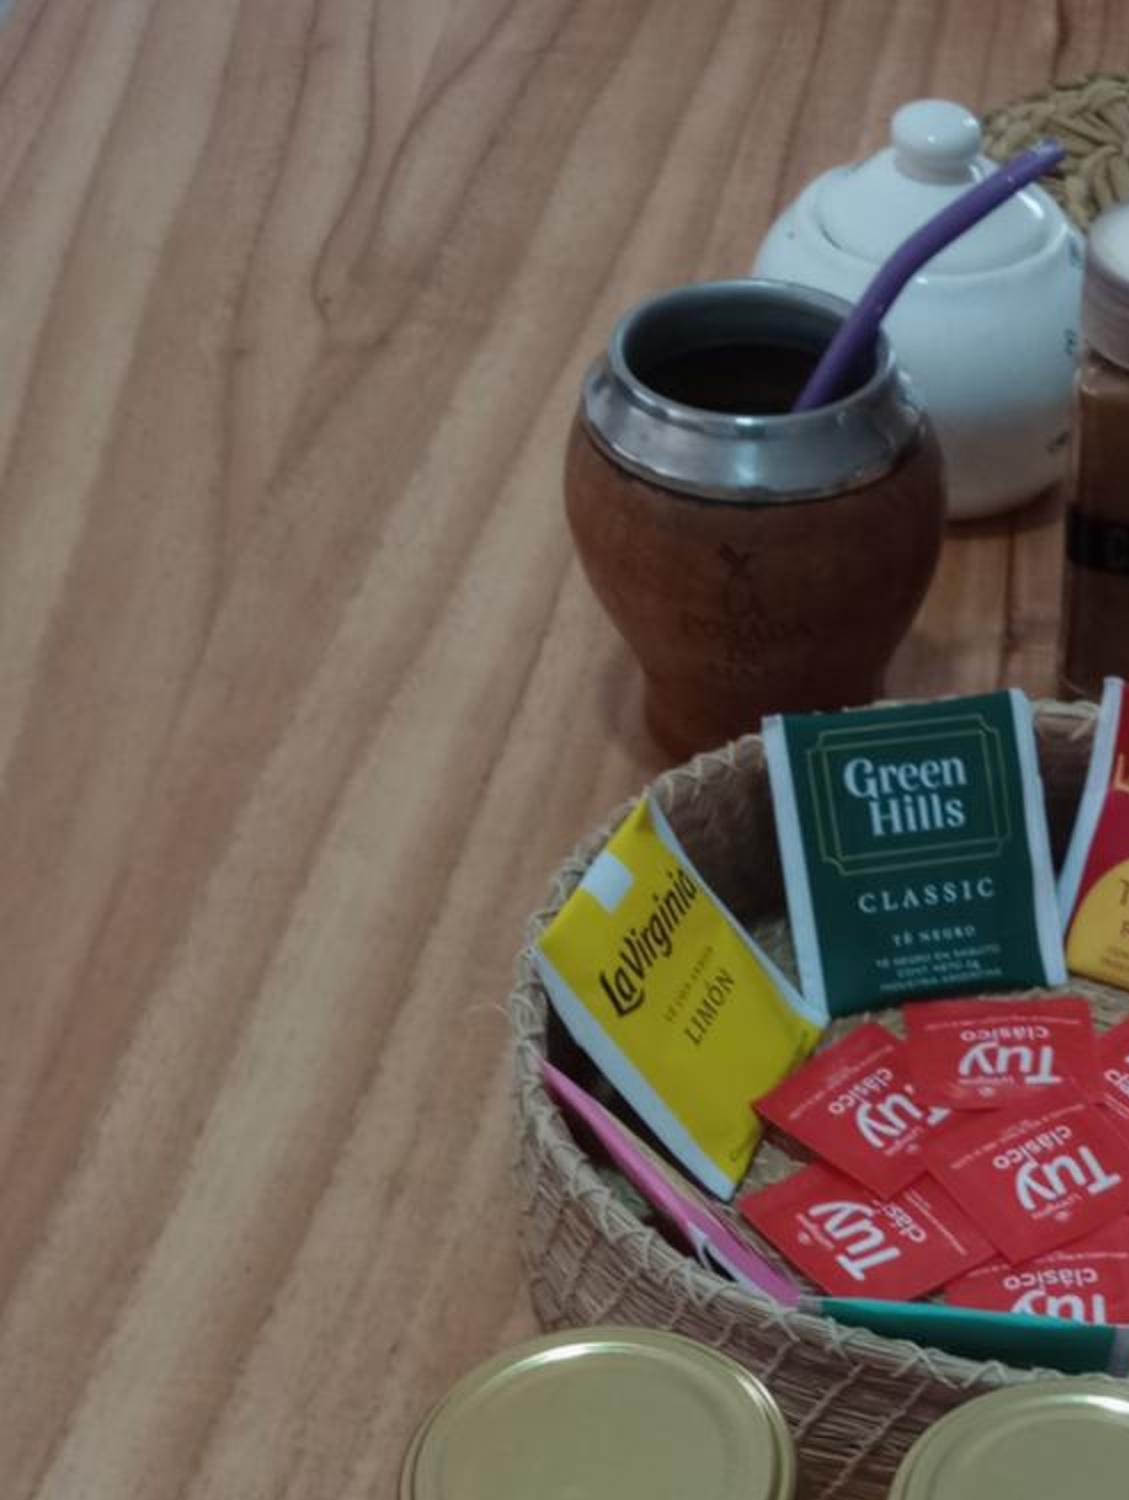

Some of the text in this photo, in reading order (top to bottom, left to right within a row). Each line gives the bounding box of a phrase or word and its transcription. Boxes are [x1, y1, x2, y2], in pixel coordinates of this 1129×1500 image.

[844, 757, 967, 799] Green
[869, 794, 965, 836] Hills
[858, 877, 995, 913] CLASSIC
[684, 967, 735, 1046] LIMÓN
[958, 1041, 1063, 1085] Tuy
[1015, 1145, 1121, 1211] Tuy
[808, 1201, 900, 1281] Tuy
